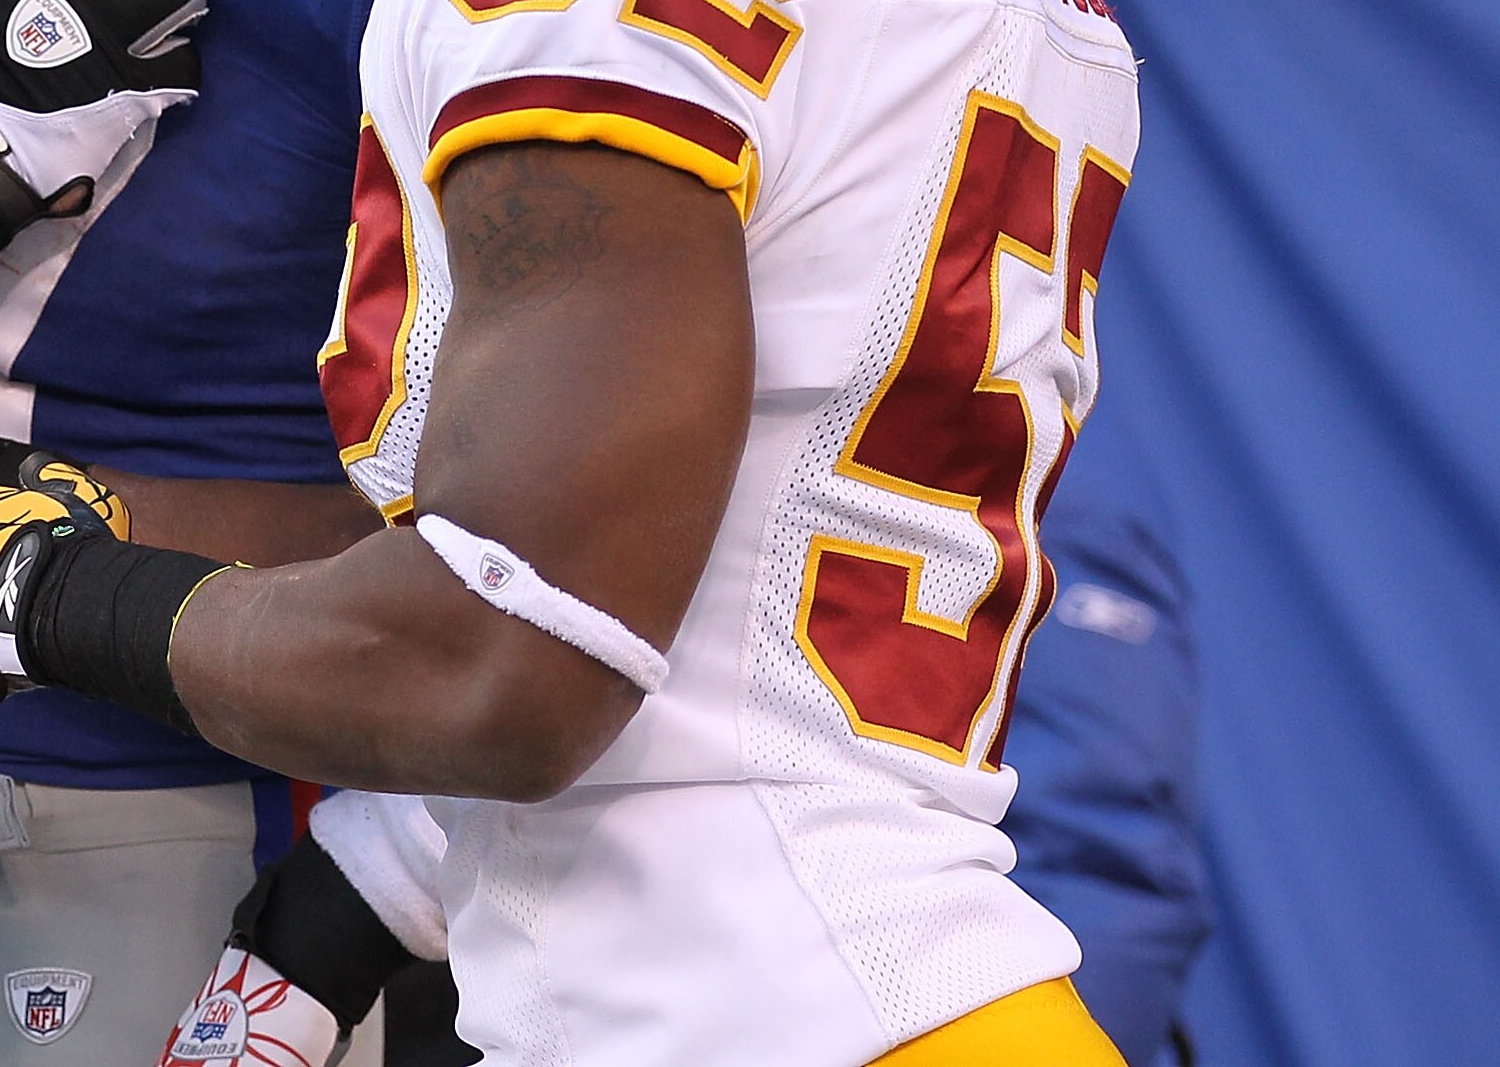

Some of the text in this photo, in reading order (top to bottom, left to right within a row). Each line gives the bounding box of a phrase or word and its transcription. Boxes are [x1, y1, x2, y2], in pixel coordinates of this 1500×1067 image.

[20, 23, 48, 54] NFL
[29, 1007, 59, 1030] NFL
[203, 1000, 235, 1024] NFL
